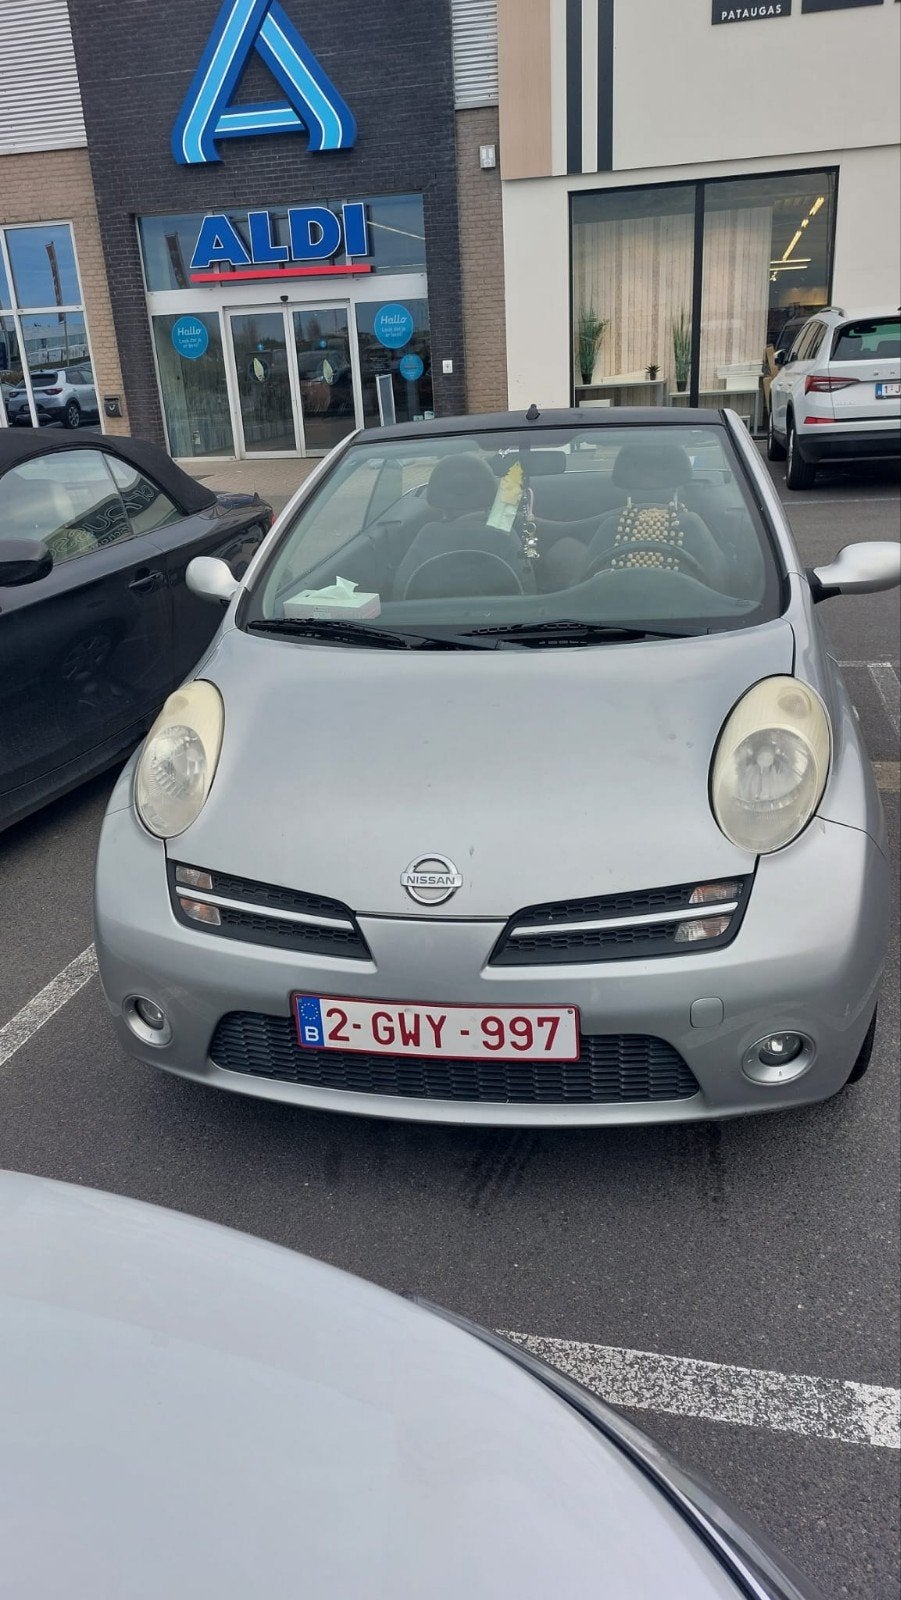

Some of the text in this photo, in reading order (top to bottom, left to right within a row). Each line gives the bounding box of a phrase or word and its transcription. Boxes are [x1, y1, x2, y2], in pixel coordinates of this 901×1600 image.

[721, 4, 782, 21] PATAUGAS
[190, 202, 369, 269] ALDI
[381, 314, 407, 325] Hallo
[177, 326, 202, 336] Hallo
[406, 875, 456, 885] NISSAN
[304, 1025, 319, 1041] B
